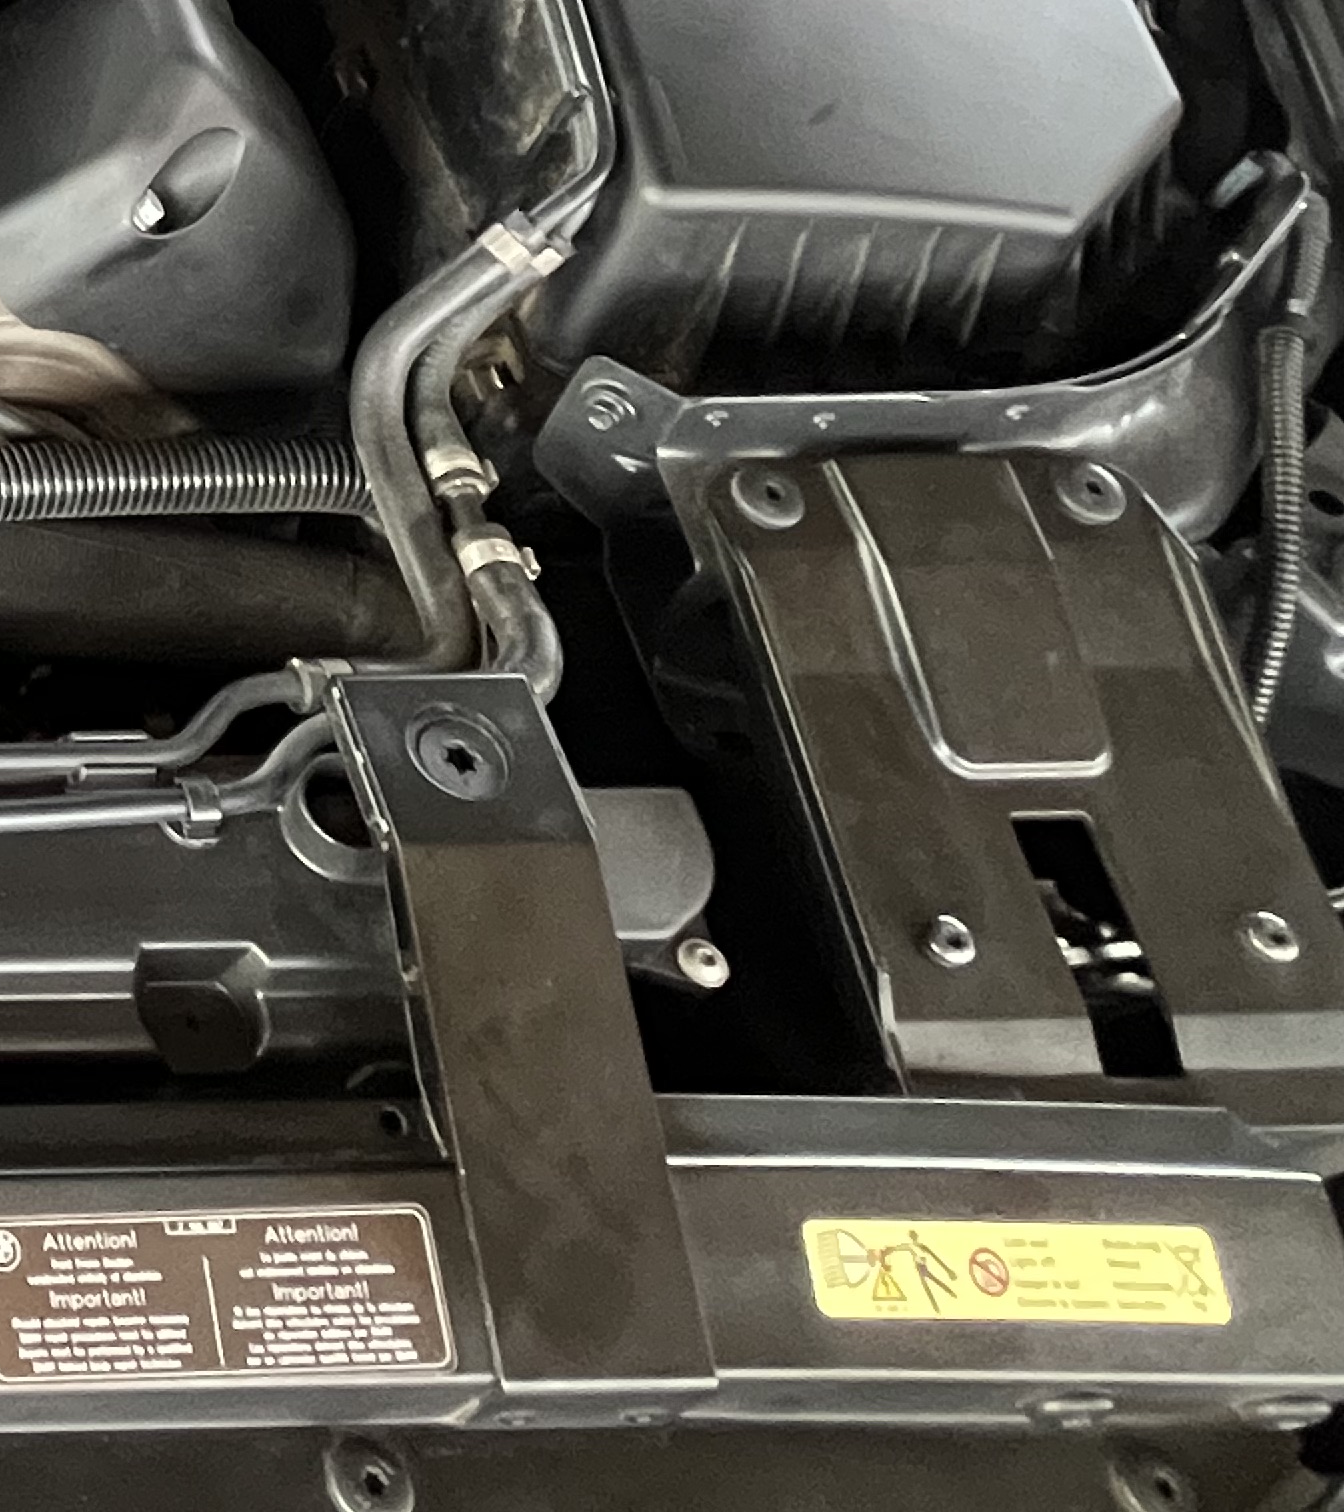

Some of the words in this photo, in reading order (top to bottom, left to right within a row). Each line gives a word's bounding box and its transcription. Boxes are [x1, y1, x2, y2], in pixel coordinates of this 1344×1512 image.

[43, 1229, 138, 1252] Attention!
[264, 1222, 359, 1245] Attention!
[49, 1287, 147, 1311] Important!
[271, 1280, 370, 1303] Important!
